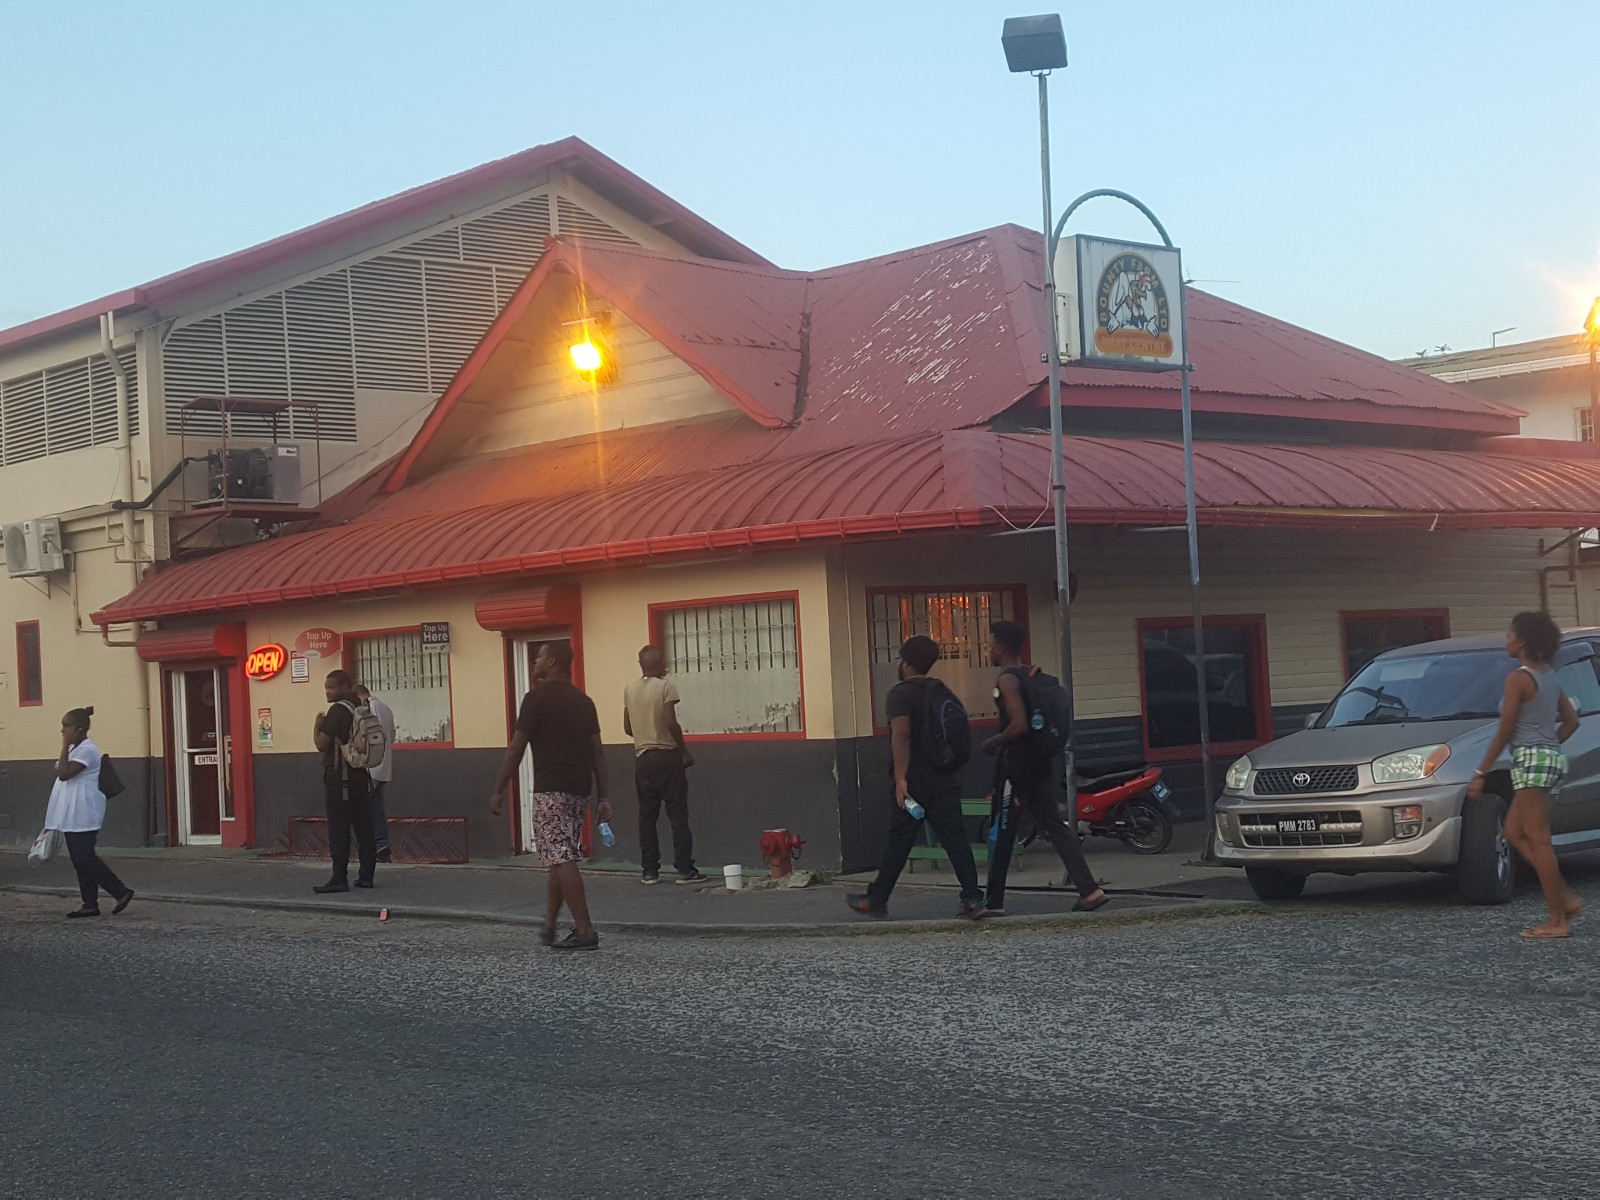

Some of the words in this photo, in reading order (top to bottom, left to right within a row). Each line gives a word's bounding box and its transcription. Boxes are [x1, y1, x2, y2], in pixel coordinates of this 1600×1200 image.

[1099, 258, 1125, 322] BOUNTY
[1131, 258, 1159, 289] FARM
[1159, 297, 1169, 329] LTD
[424, 624, 437, 632] Top
[305, 632, 319, 641] Top
[321, 631, 332, 640] Up
[423, 631, 449, 642] Here
[309, 640, 328, 649] Here
[247, 651, 280, 674] OPEN
[198, 755, 219, 764] ENTRA
[1278, 820, 1297, 832] PMM
[1297, 819, 1316, 831] 2783
